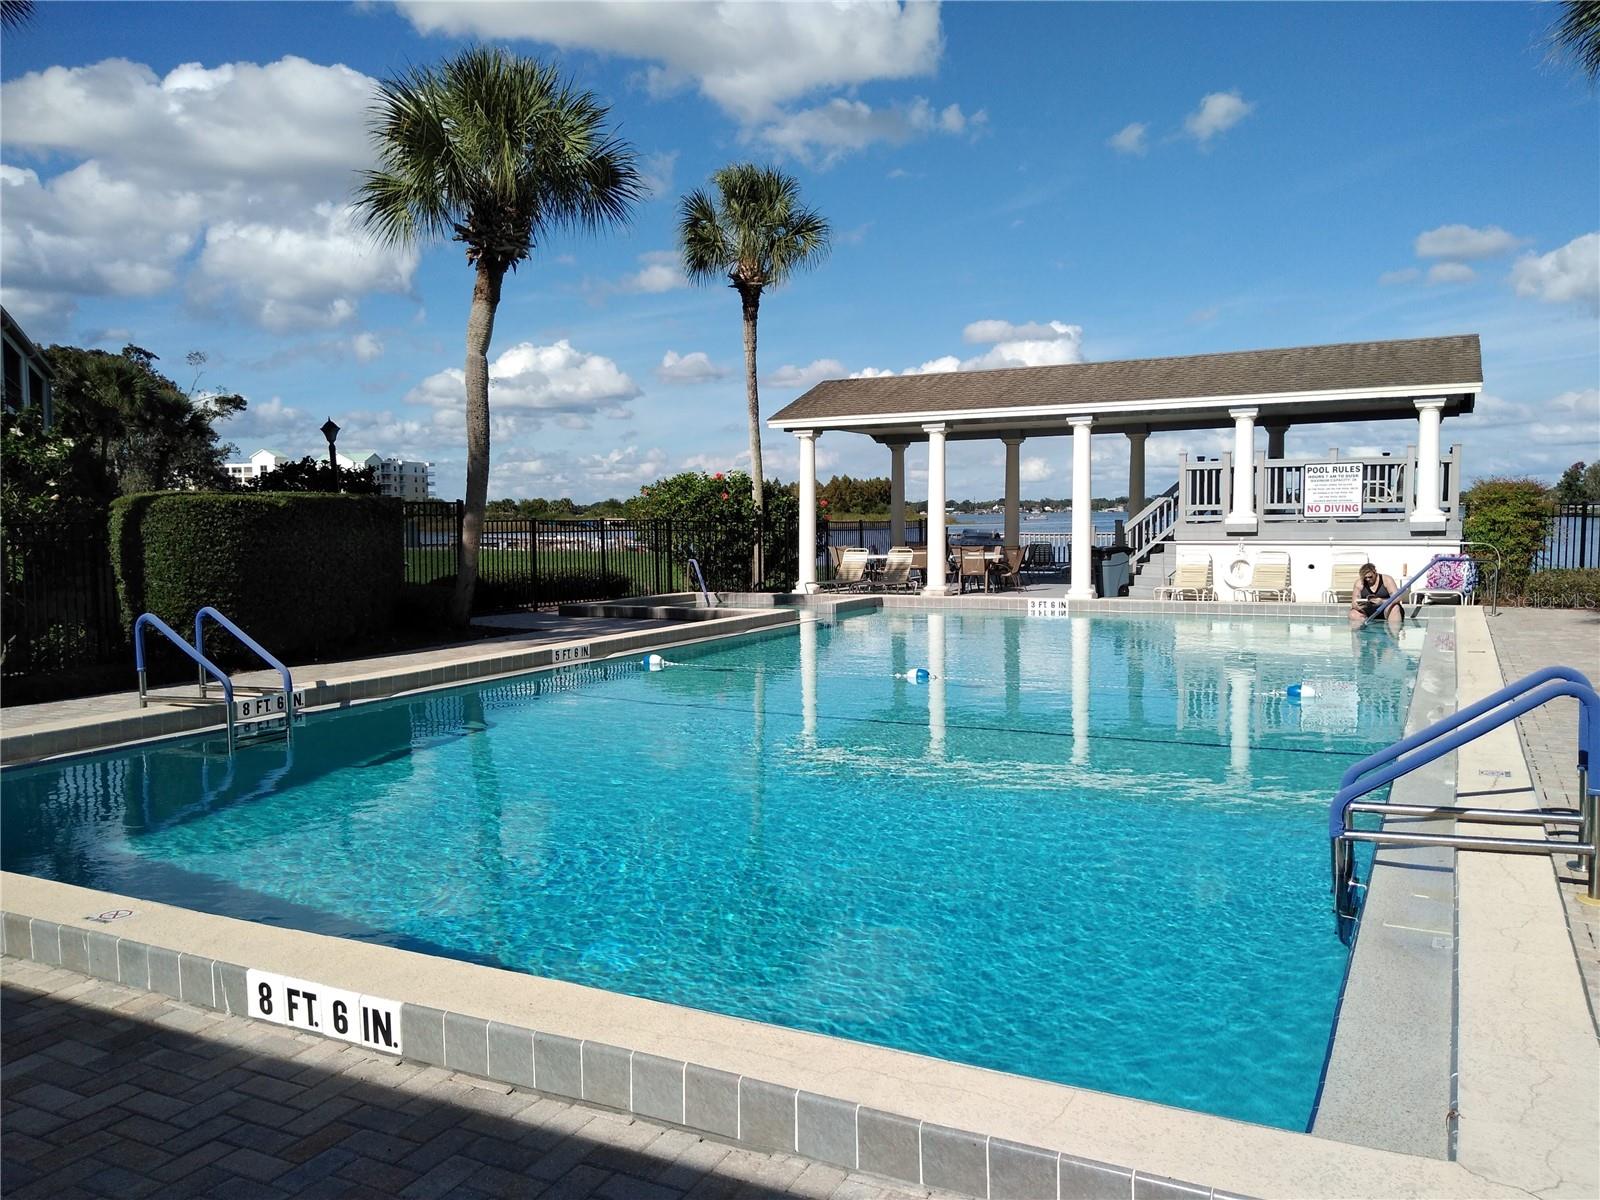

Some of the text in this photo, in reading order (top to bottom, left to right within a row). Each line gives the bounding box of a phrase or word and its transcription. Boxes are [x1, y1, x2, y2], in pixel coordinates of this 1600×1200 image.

[1307, 465, 1361, 474] POOL RULES
[1307, 504, 1359, 512] NO DIVING
[1030, 600, 1035, 608] 3
[555, 650, 560, 661] 5
[574, 647, 579, 658] 6
[243, 702, 250, 715] 8
[256, 698, 271, 714] FT.
[277, 696, 284, 709] 6
[258, 982, 399, 1049] 8 FT. 6 IN.
